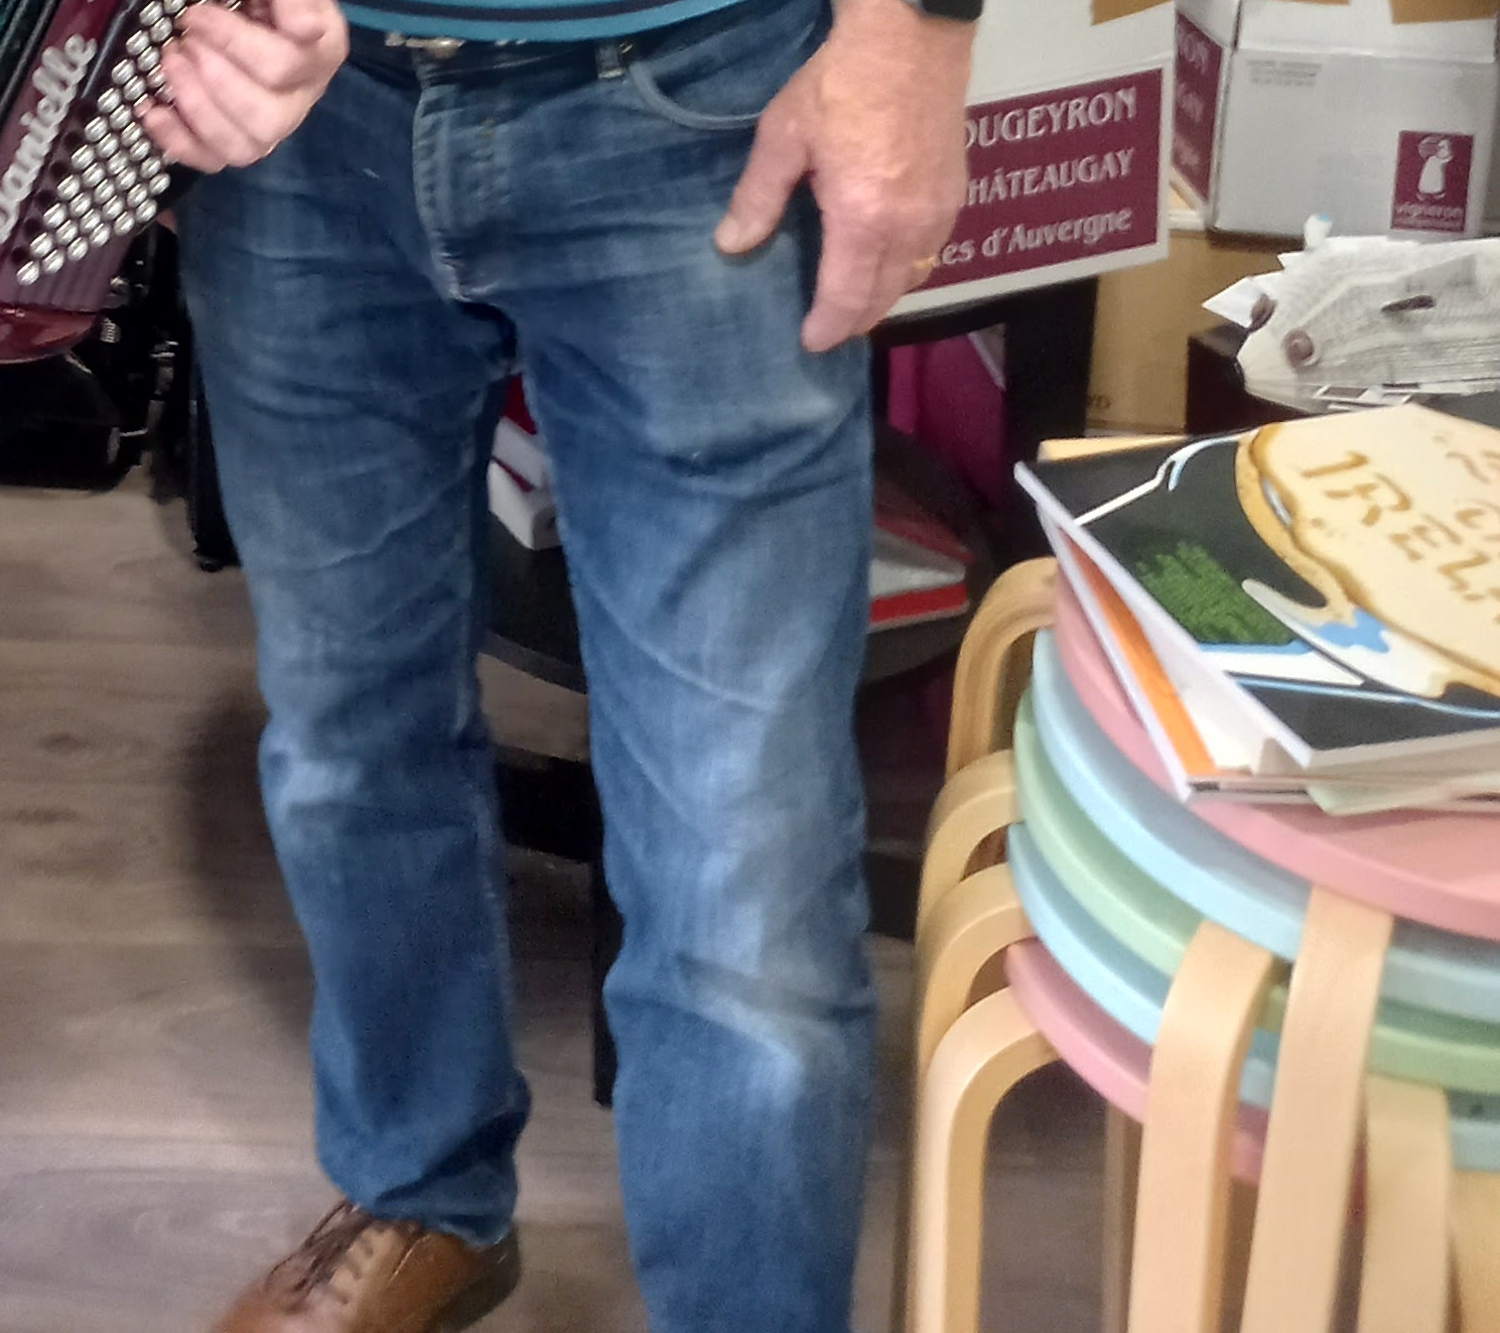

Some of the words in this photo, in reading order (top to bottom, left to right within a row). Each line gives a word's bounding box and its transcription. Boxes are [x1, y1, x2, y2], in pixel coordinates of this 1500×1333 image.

[965, 87, 1137, 148] UGEYRON
[968, 148, 1134, 205] HÂTEAUGAY
[981, 207, 1133, 257] d'Auvergne
